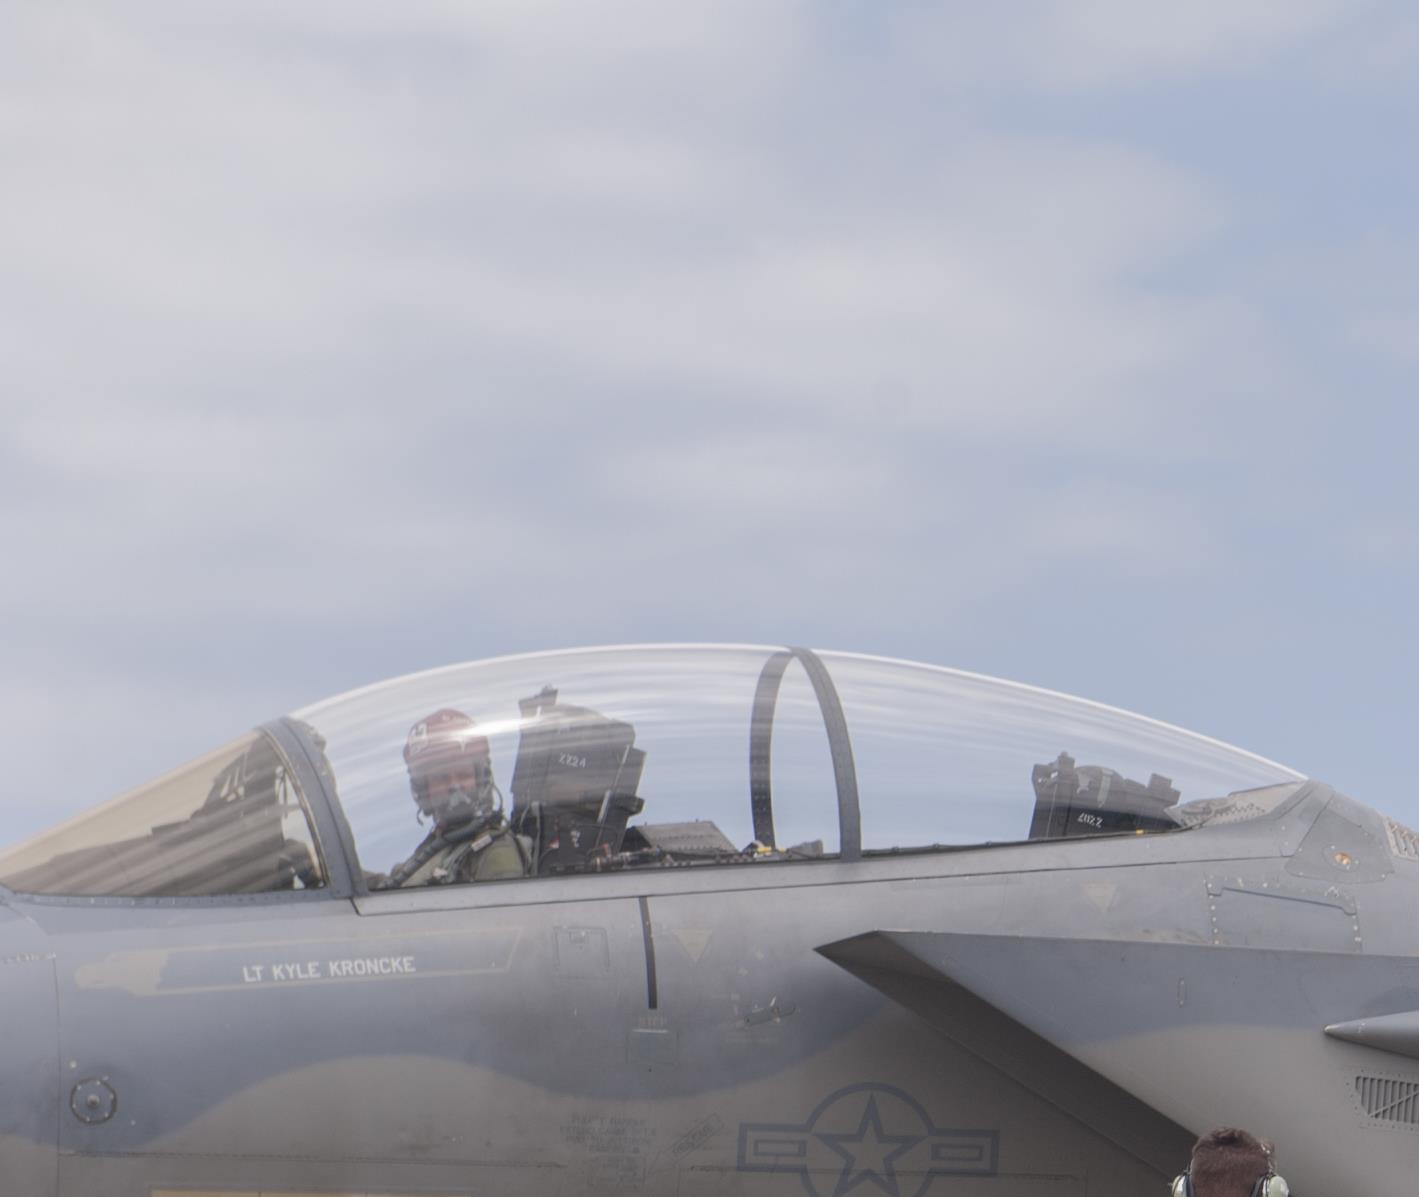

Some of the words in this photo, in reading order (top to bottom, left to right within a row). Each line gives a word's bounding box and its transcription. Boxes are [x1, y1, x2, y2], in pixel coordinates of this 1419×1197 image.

[242, 964, 265, 983] LT
[272, 961, 321, 981] KYLE
[328, 955, 417, 977] KRONCKE
